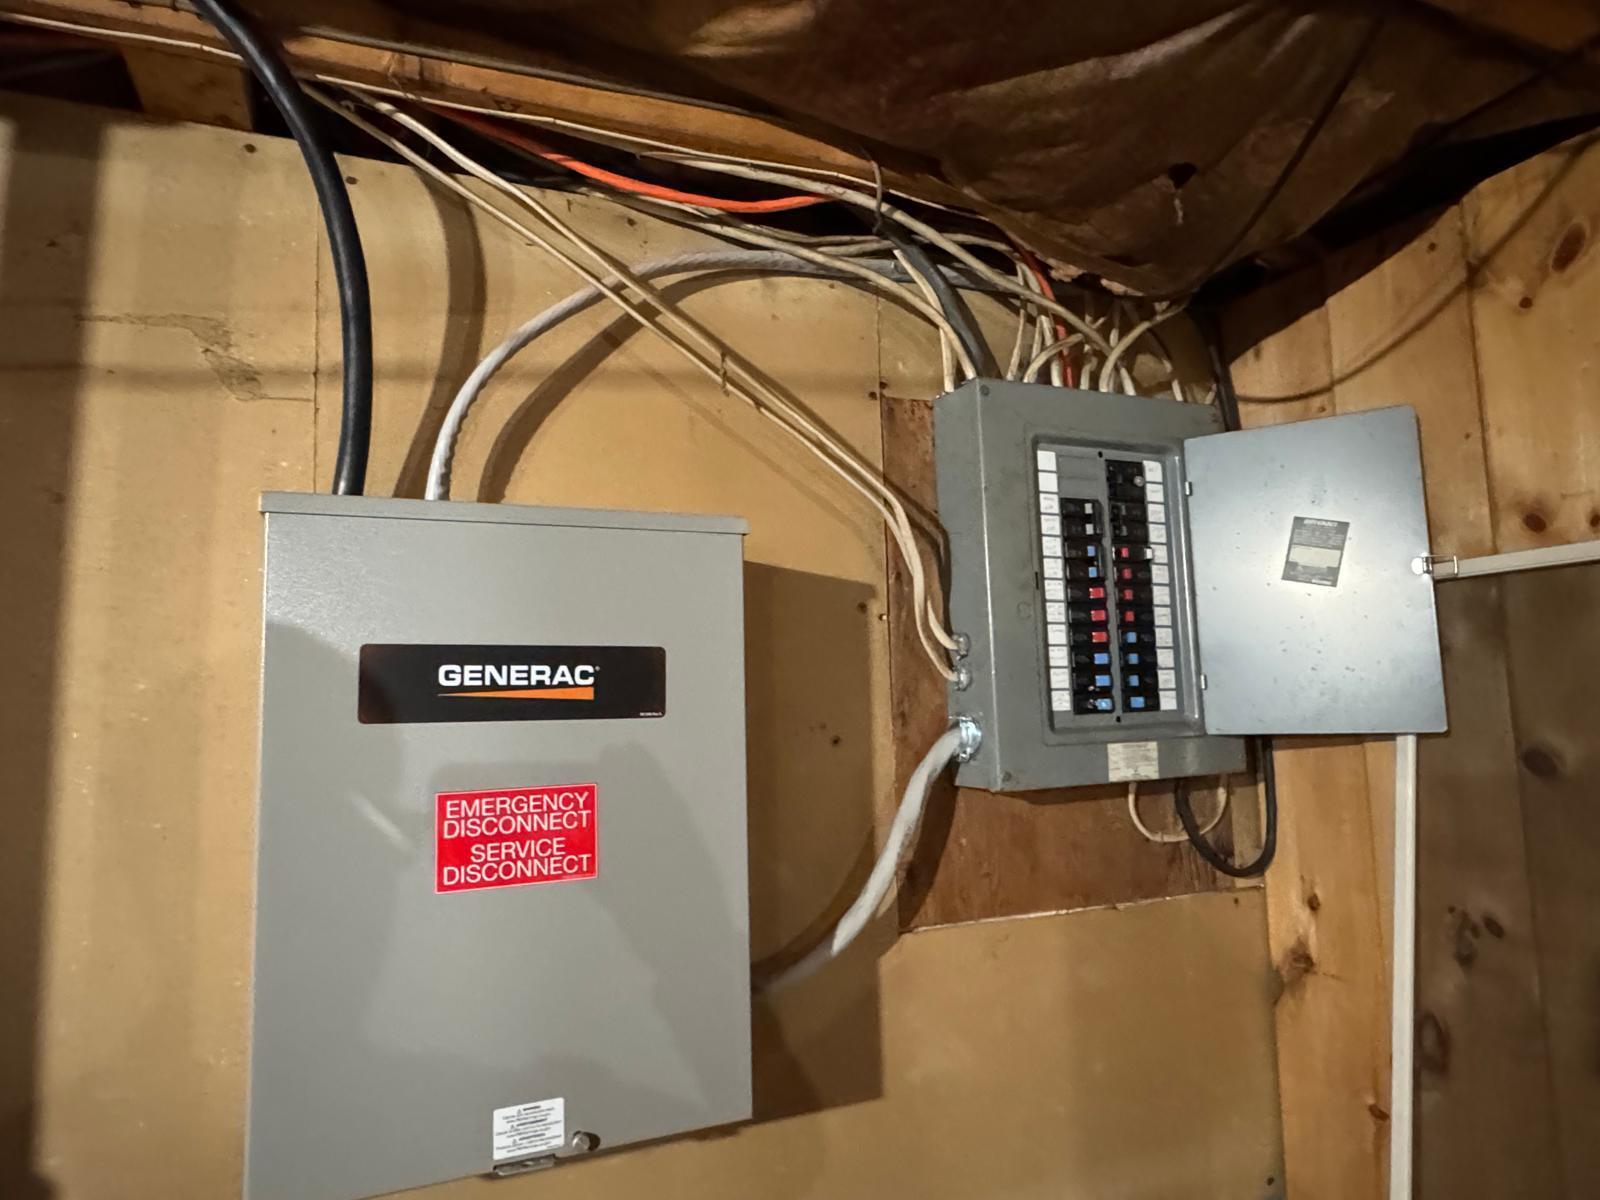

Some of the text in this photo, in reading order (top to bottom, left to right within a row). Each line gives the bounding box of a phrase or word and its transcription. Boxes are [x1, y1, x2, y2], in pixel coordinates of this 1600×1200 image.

[438, 664, 595, 687] GENERAC
[446, 791, 589, 819] EMERGENCY
[443, 810, 592, 839] DISCONNECT
[470, 837, 566, 863] SERVICE
[443, 853, 592, 886] DISCONNECT
